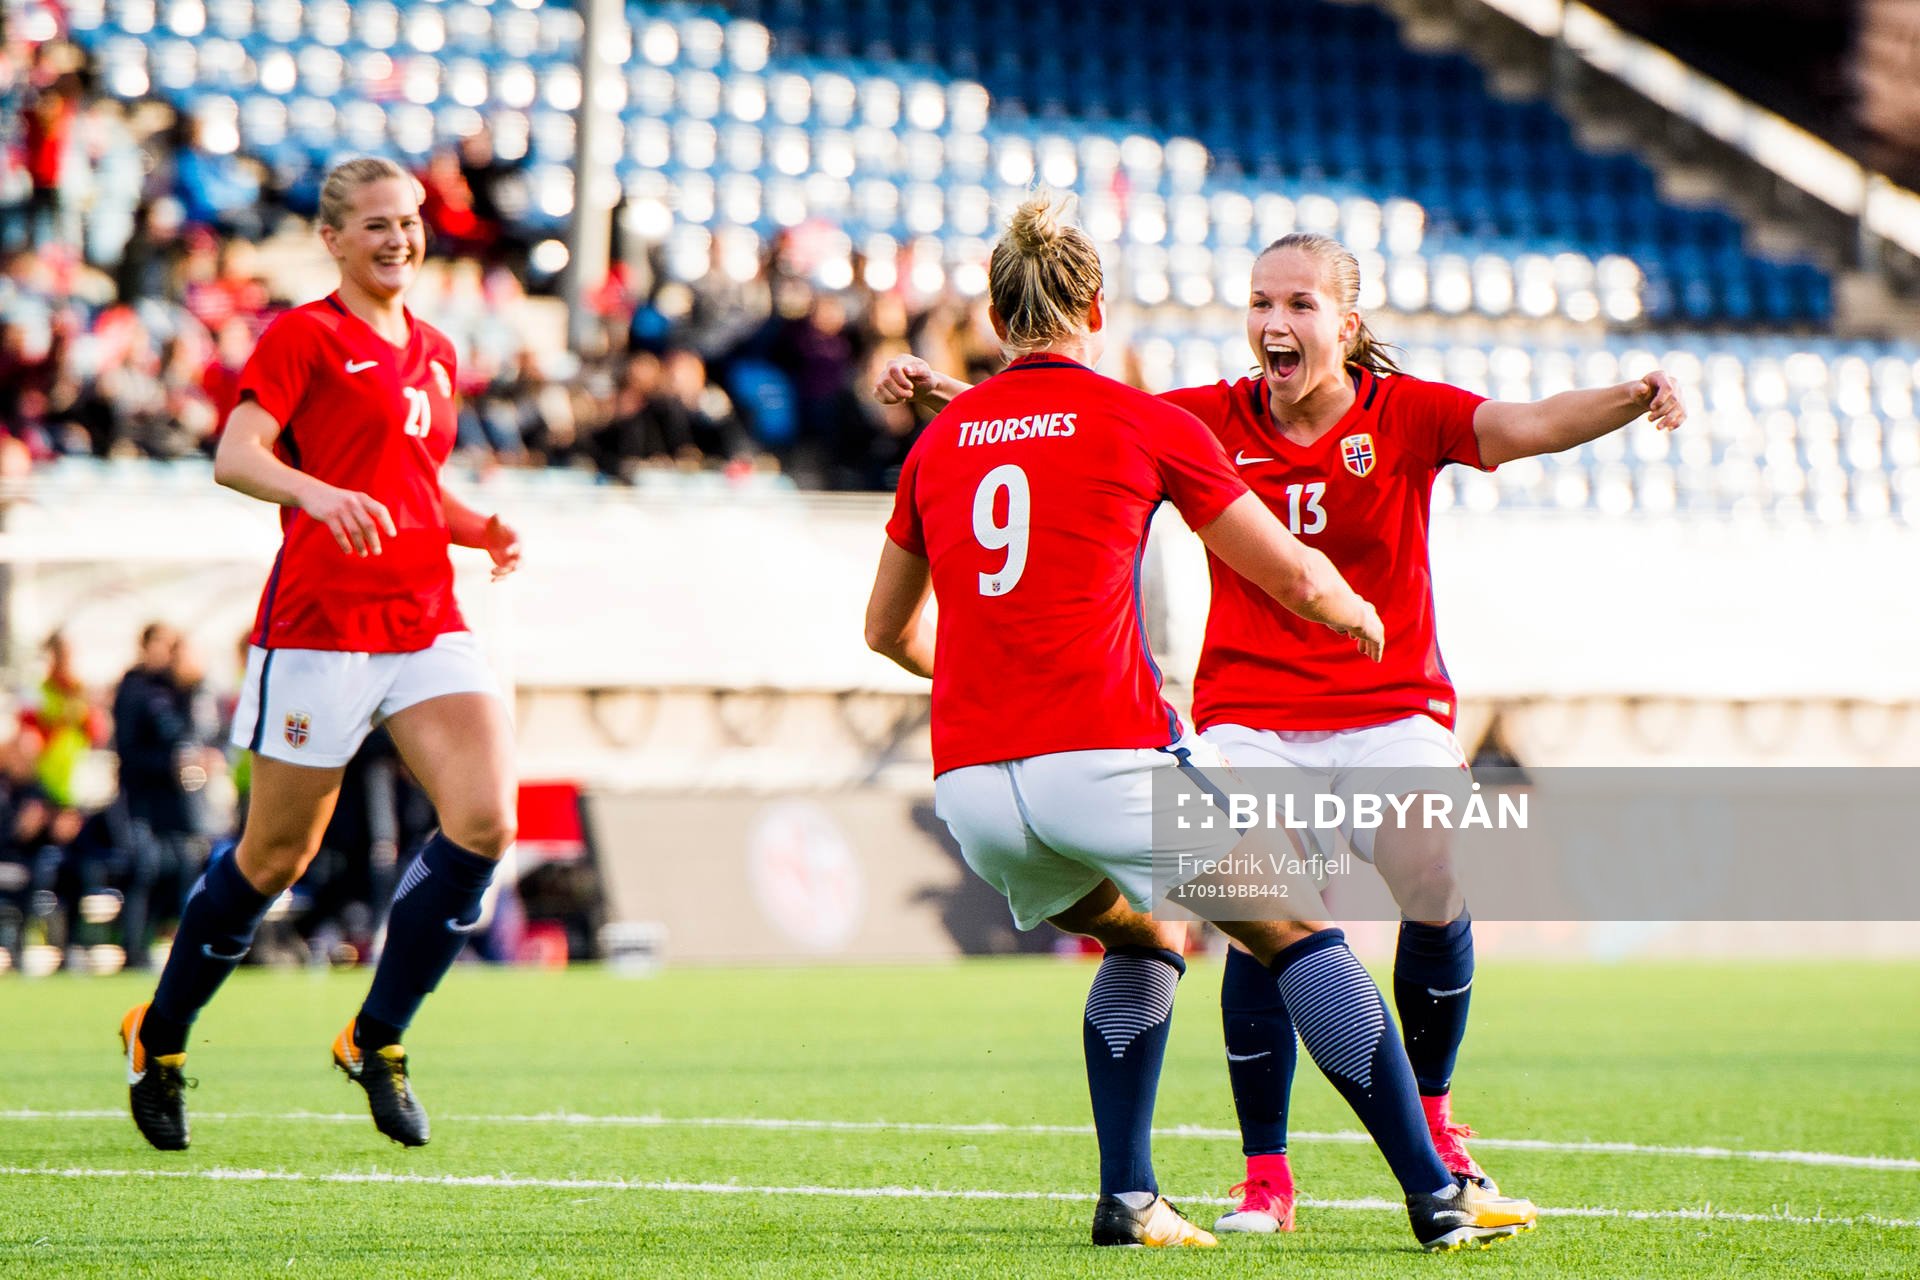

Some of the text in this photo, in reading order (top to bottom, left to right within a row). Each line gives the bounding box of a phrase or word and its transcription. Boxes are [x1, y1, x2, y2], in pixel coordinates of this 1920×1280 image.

[958, 413, 1077, 447] THORSNES
[972, 464, 1031, 597] 9
[1285, 482, 1327, 535] 13
